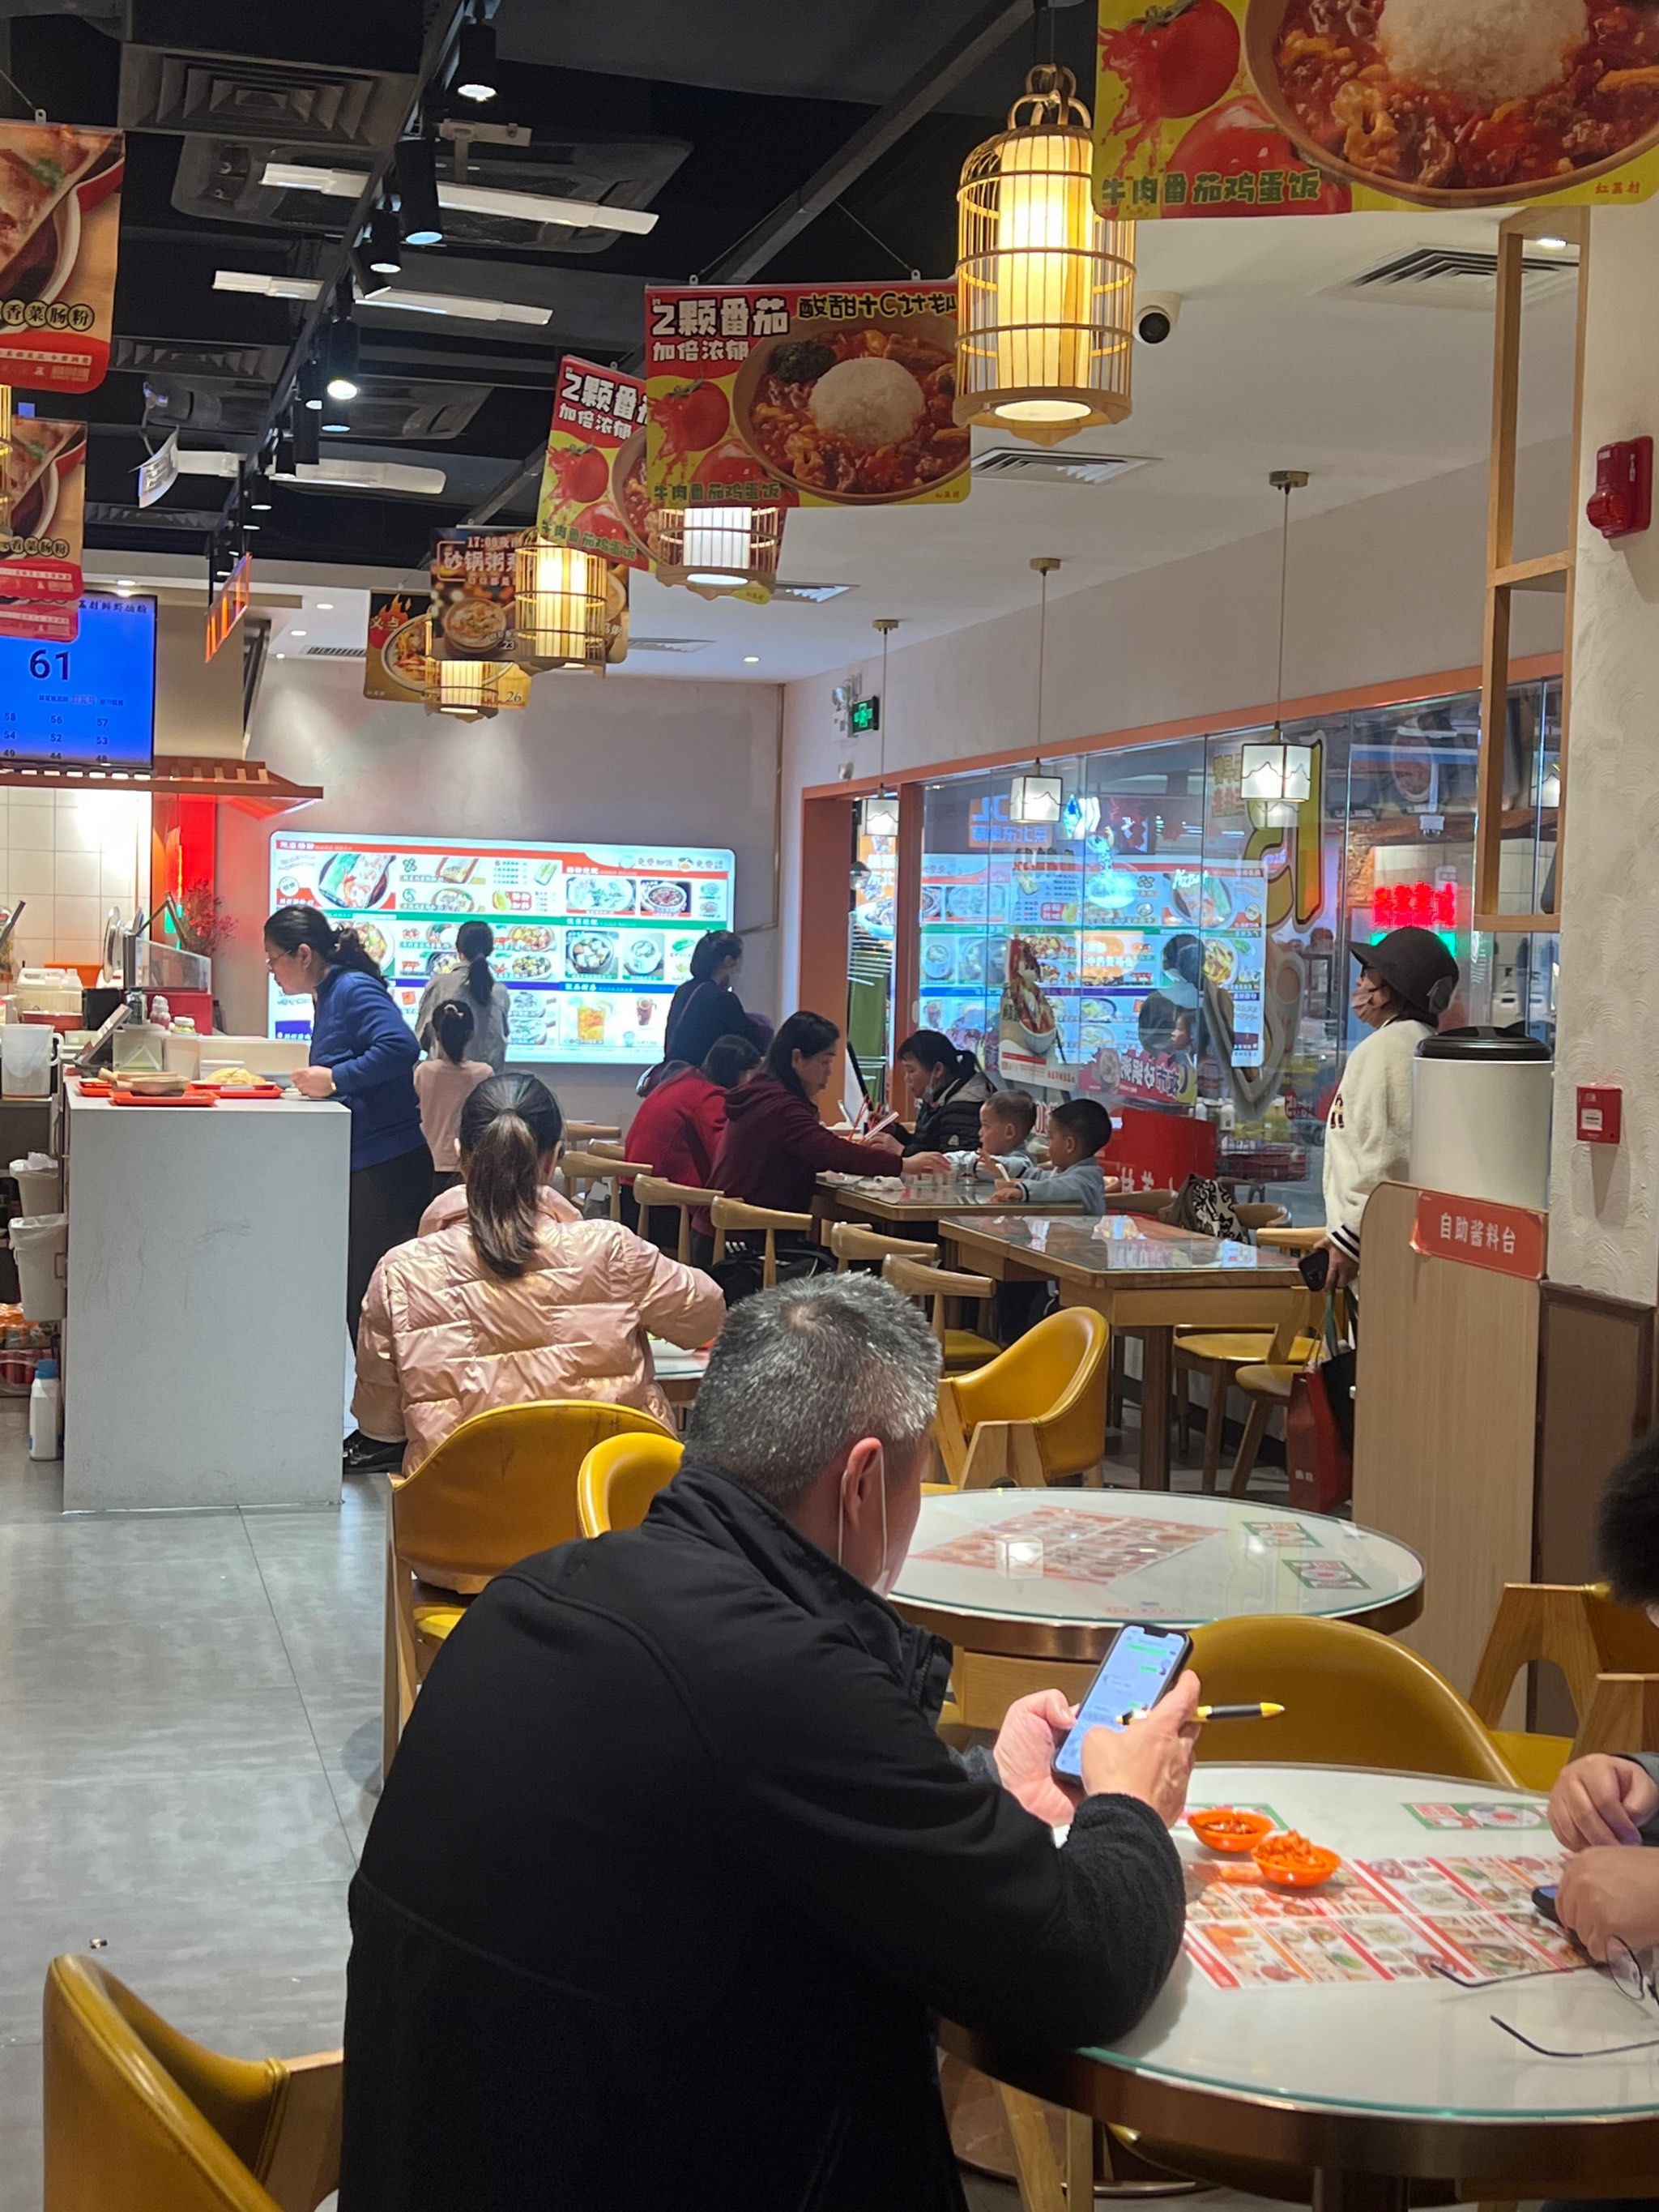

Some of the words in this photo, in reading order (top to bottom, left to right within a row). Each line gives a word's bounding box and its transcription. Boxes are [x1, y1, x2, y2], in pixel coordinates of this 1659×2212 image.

[1102, 169, 1322, 207] 牛肉番茄鸡蛋饭
[1594, 181, 1641, 196] 红荔村
[4, 301, 91, 328] 香菜肠粉
[652, 339, 750, 363] 加倍浓郁
[557, 402, 633, 441] 加倍浓郁
[654, 481, 781, 502] 牛肉番茄鸡蛋饭
[541, 519, 638, 562] 牛肉番茄鸡蛋饭
[29, 649, 70, 681] 61
[505, 691, 522, 702] 26
[50, 715, 63, 725] 56
[96, 717, 109, 728] 57
[3, 731, 16, 741] 54
[50, 733, 63, 743] 52
[96, 736, 109, 745] 53
[3, 749, 15, 758] 49
[1439, 1212, 1516, 1255] 自助酱料台
